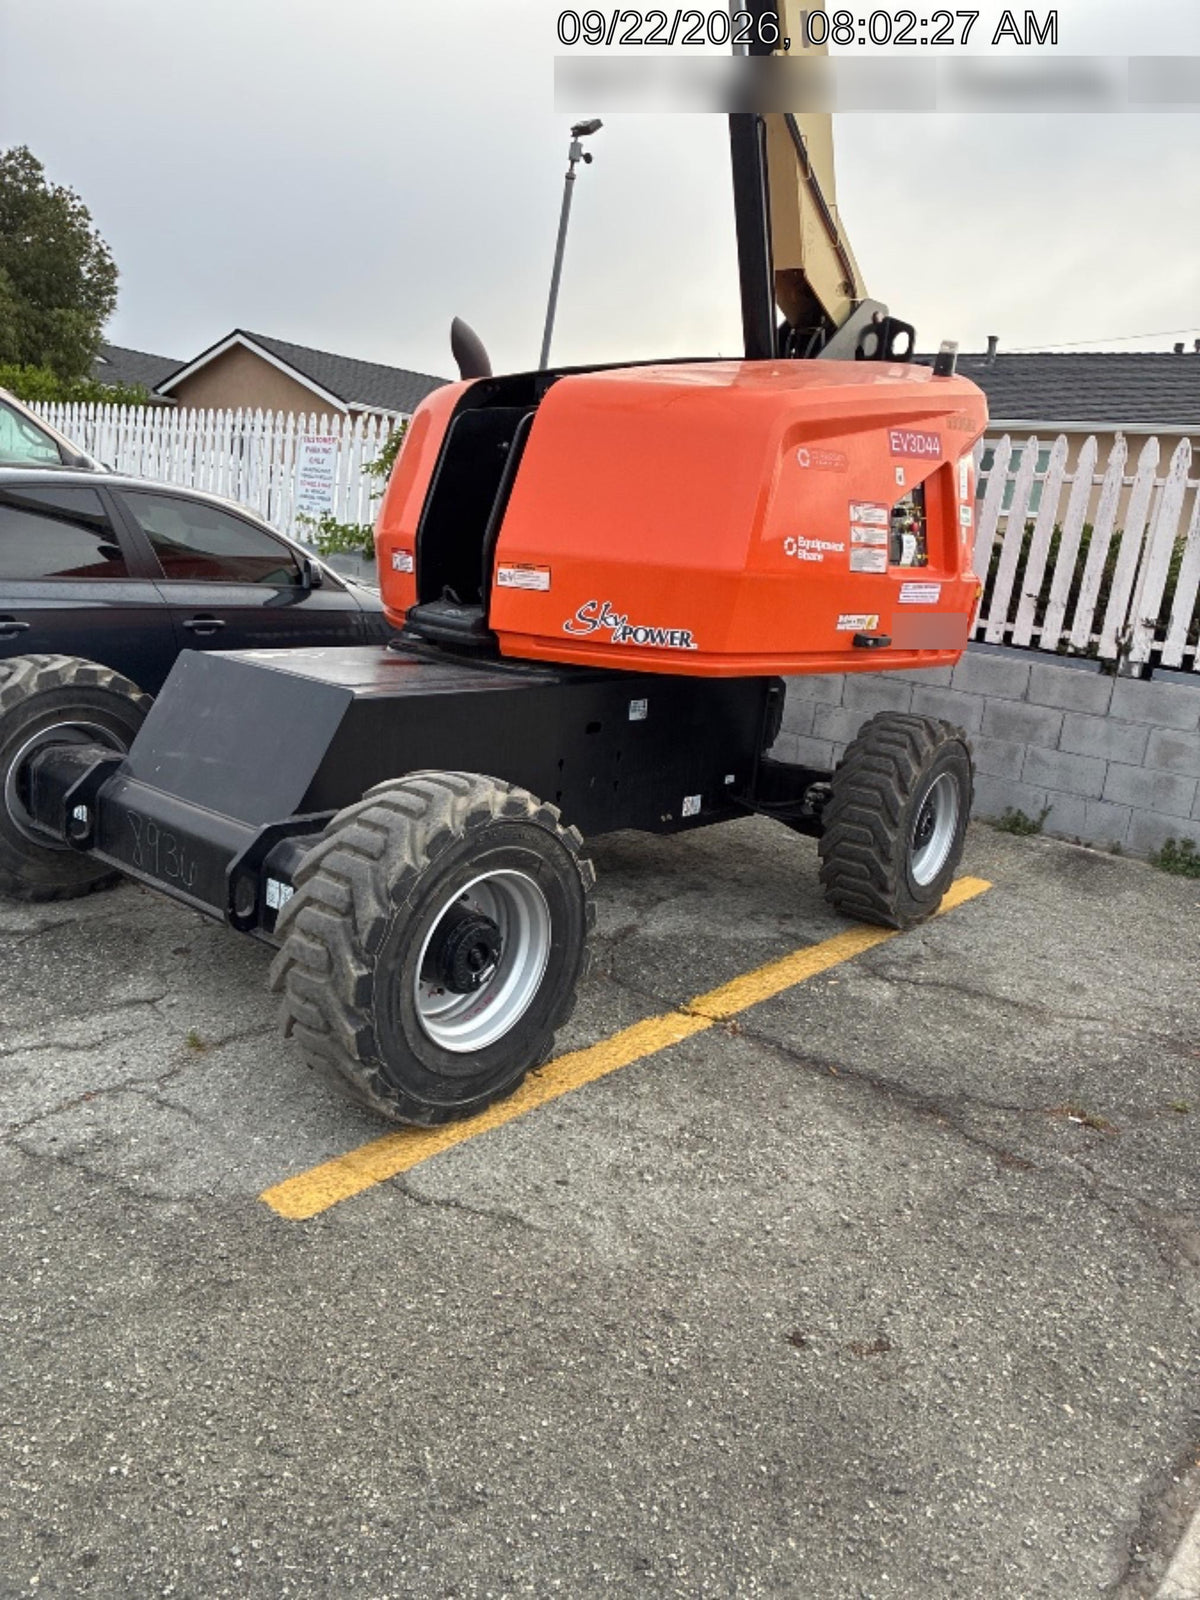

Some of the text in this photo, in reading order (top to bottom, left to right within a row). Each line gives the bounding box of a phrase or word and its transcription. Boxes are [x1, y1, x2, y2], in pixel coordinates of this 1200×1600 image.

[889, 431, 940, 455] EV3D44
[797, 535, 845, 552] Equipment
[797, 549, 824, 562] Share
[563, 600, 628, 644] Sky
